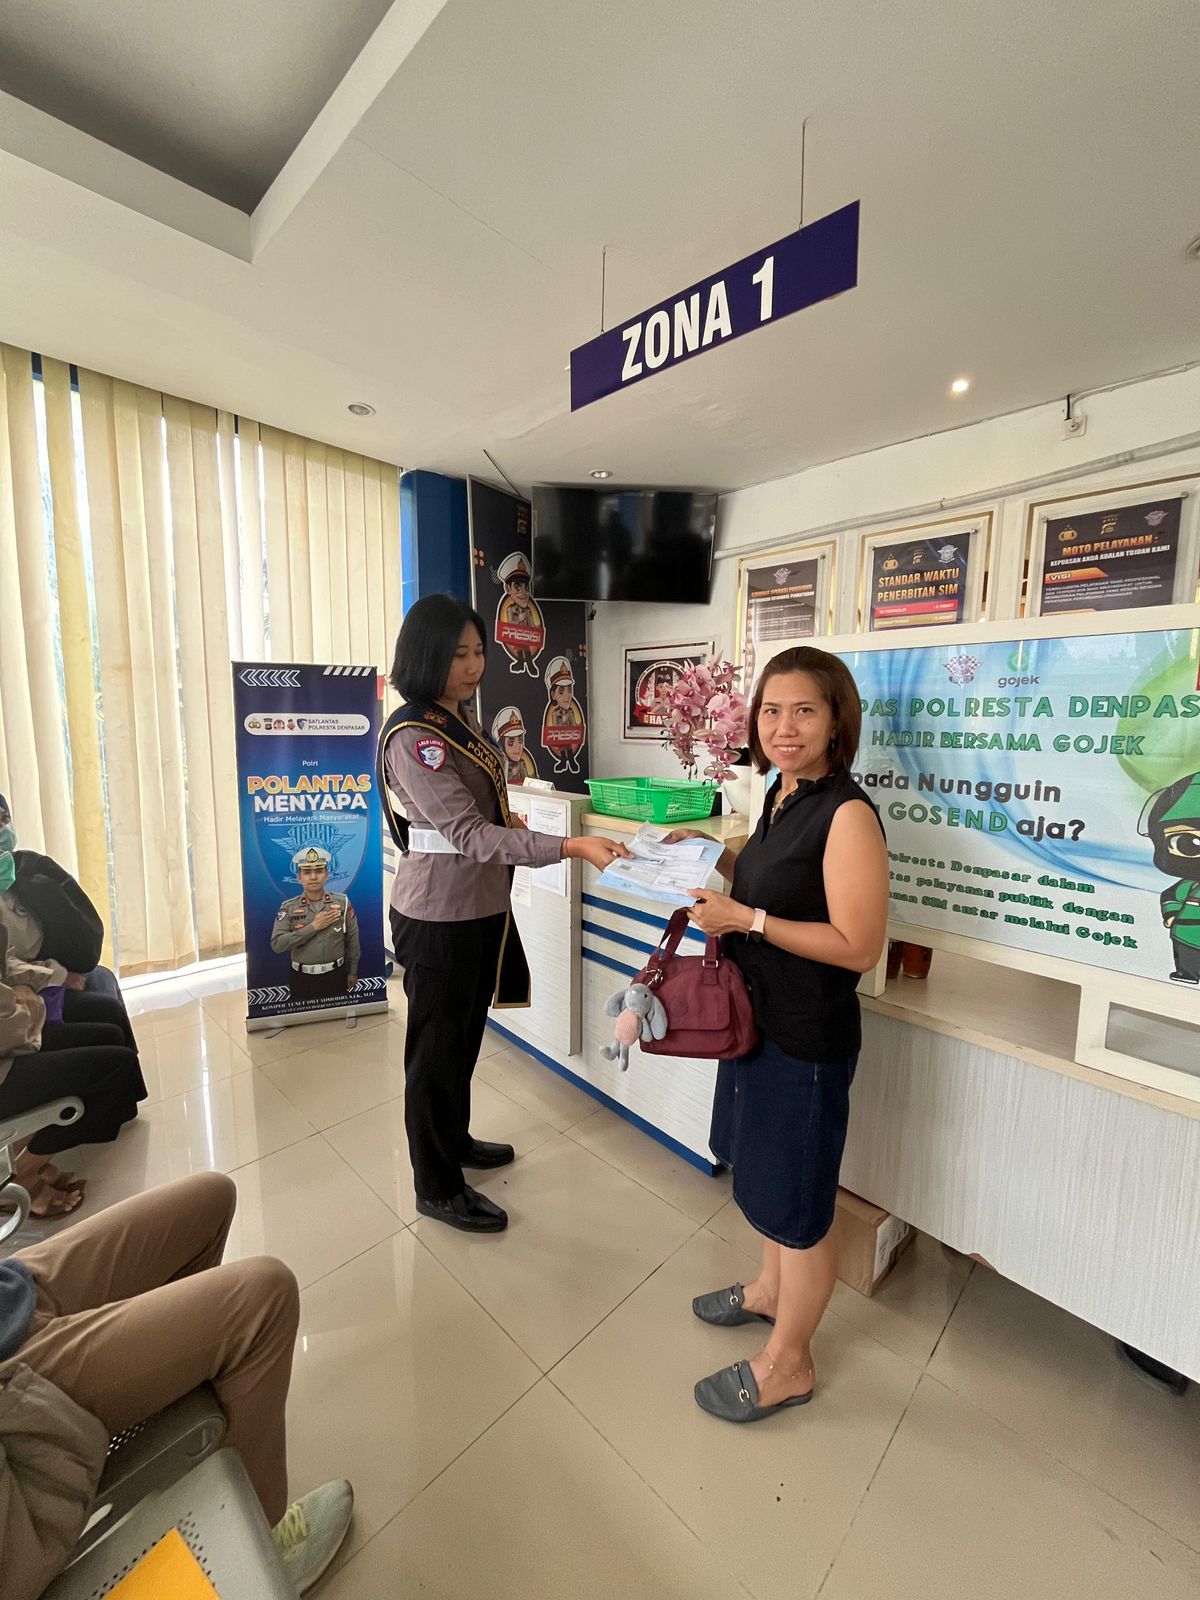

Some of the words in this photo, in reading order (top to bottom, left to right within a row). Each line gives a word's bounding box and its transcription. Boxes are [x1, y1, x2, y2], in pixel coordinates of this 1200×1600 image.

[621, 280, 733, 382] ZONA
[752, 255, 775, 322] 1
[1050, 556, 1082, 567] KEPUASAN
[1082, 554, 1099, 563] ANDA
[1126, 548, 1151, 557] TUJUAN
[1151, 544, 1170, 553] KAMI
[1062, 543, 1092, 556] MOTO
[1094, 534, 1153, 552] PELAYANAN
[878, 573, 921, 588] STANDAR
[923, 567, 960, 582] WAKTU
[1050, 572, 1071, 581] VISI
[877, 585, 936, 602] PENERBITAN
[938, 583, 959, 596] SIM
[501, 626, 541, 644] PRESISI
[998, 675, 1040, 688] gojek
[910, 696, 1054, 718] POLRESTA
[872, 730, 935, 748] HADIR
[940, 731, 1042, 751] BERSAMA
[1053, 734, 1145, 755] GOJEK
[247, 774, 372, 795] POLANTAS
[918, 773, 1061, 803] Nungguin
[254, 793, 368, 813] MENYAPA
[285, 815, 318, 824] Melayani
[319, 813, 360, 822] Masyarakat
[888, 801, 1008, 832] GOSEND
[1016, 816, 1085, 842] aja?
[950, 860, 1032, 882] Denpasar
[1037, 875, 1095, 894] dalam
[916, 877, 994, 898] pelayanan
[998, 892, 1054, 909] publik
[1062, 902, 1135, 924] dengan
[921, 895, 948, 910] SIM
[952, 904, 999, 920] antar
[1004, 914, 1070, 935] melalui
[1075, 926, 1138, 949] Gojek
